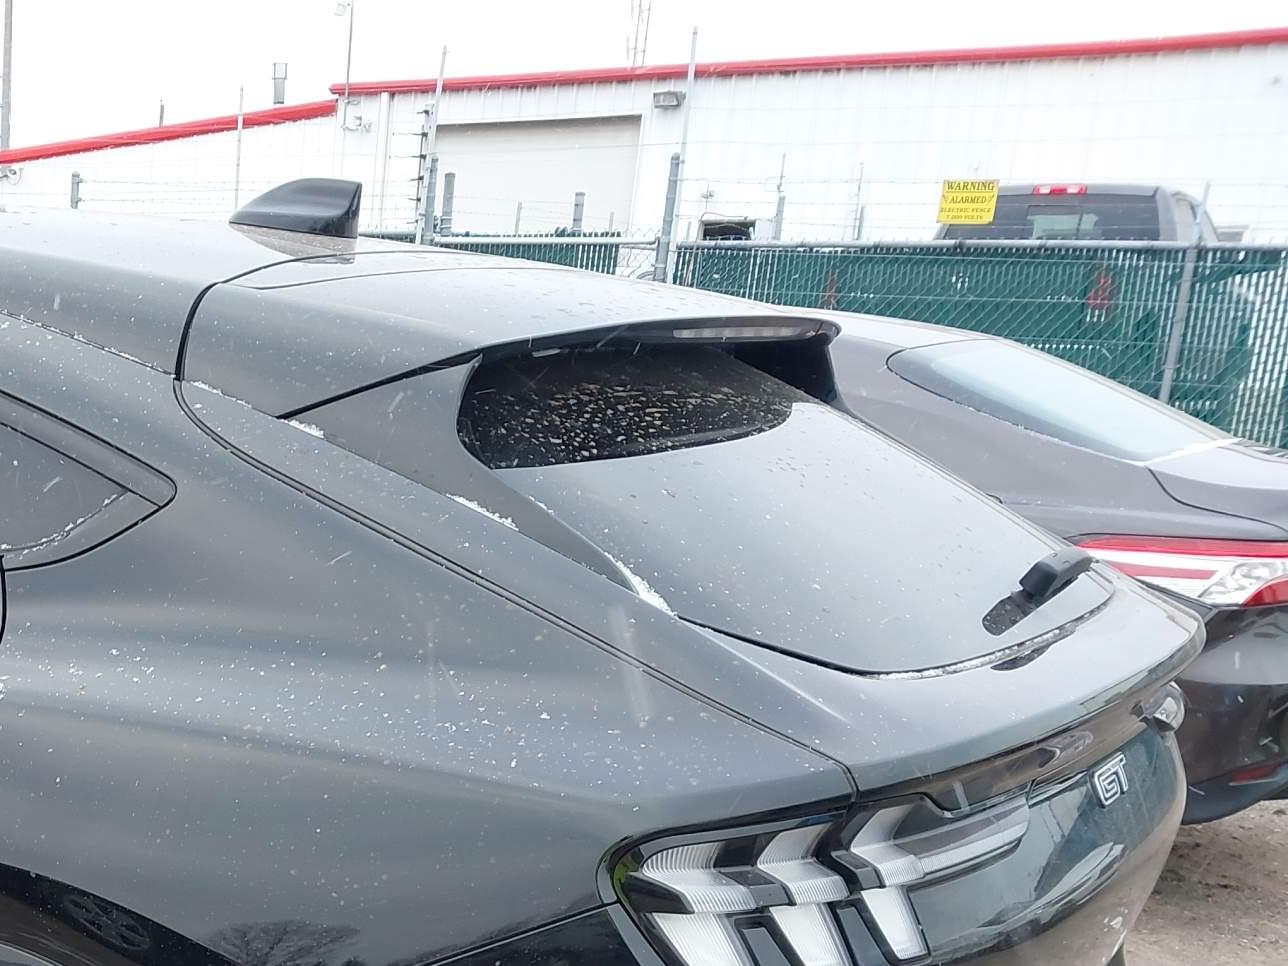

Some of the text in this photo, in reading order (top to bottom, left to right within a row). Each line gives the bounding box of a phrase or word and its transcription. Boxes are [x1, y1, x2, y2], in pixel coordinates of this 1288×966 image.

[947, 181, 995, 191] WARNING
[949, 195, 986, 204] ALARMED
[1094, 752, 1128, 806] GT
